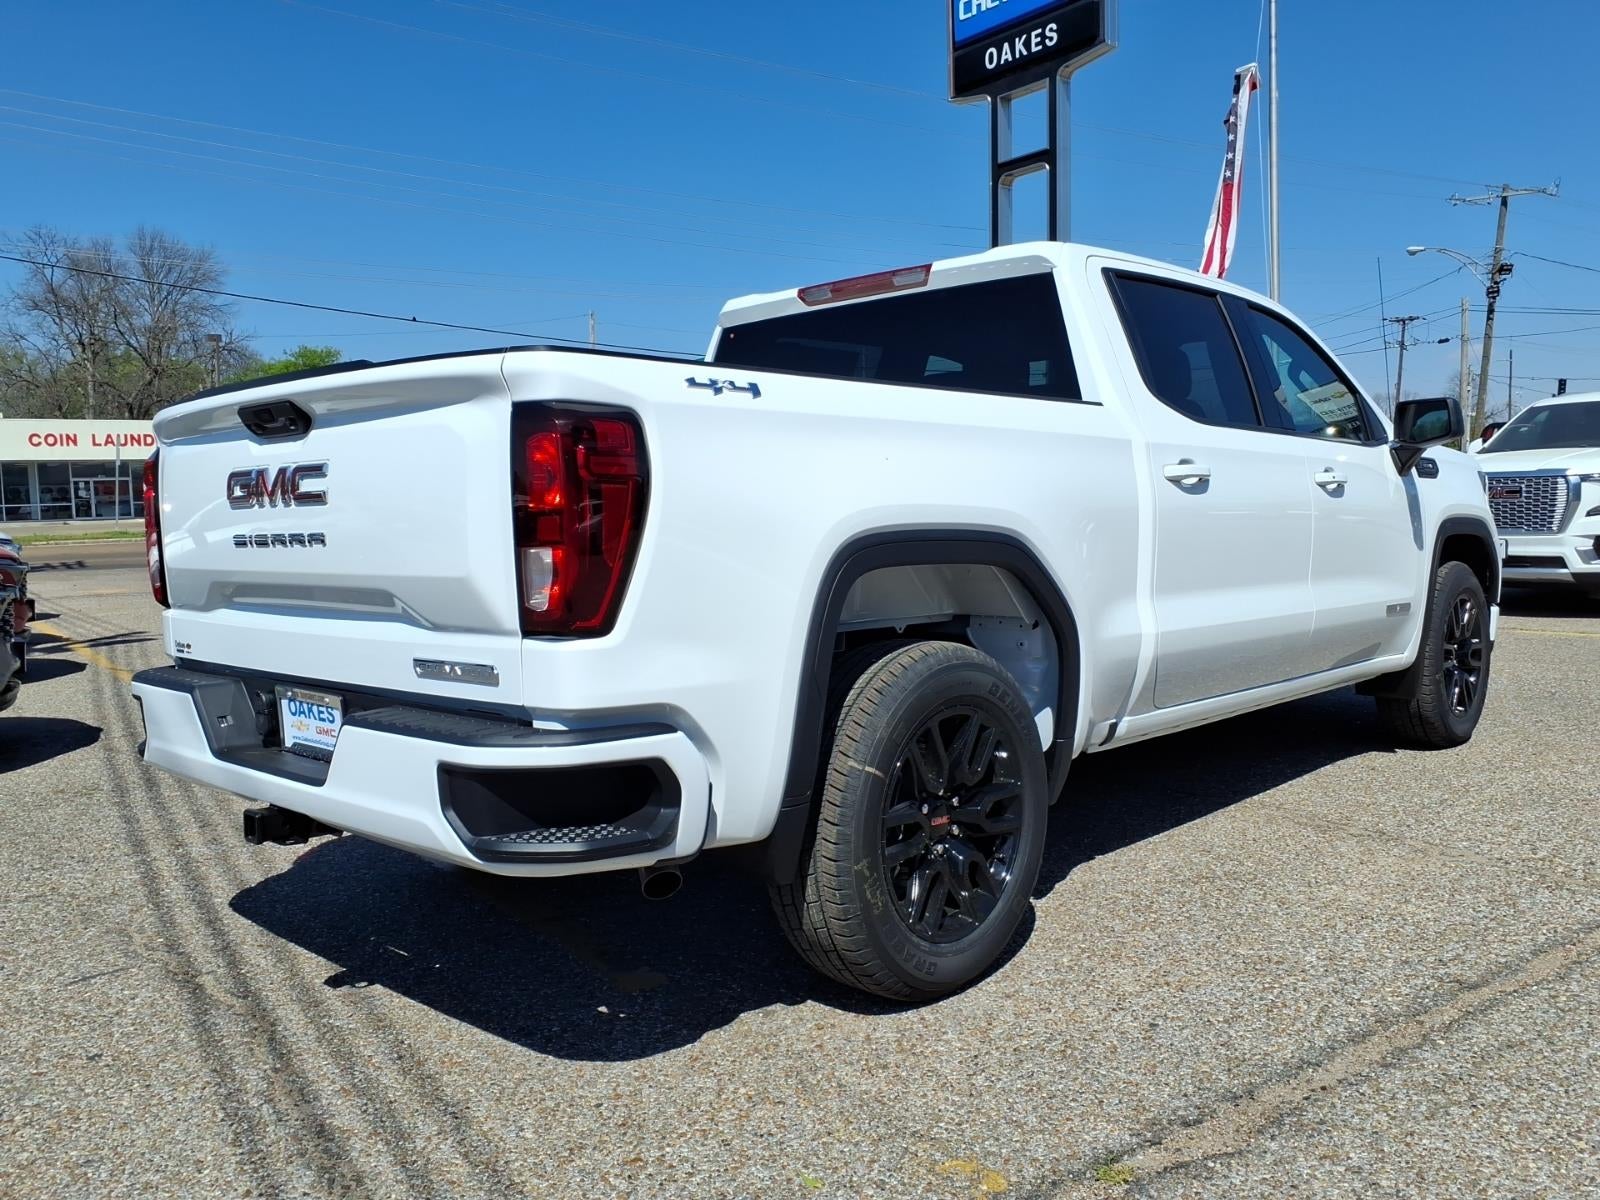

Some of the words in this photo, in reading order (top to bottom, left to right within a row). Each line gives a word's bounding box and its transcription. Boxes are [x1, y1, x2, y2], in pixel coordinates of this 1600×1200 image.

[984, 23, 1058, 69] OAKES
[28, 433, 78, 447] COIN
[227, 462, 329, 510] GMC
[232, 532, 327, 548] SIERRA
[287, 697, 336, 724] OAKES
[315, 725, 337, 738] GMC
[931, 815, 951, 826] GMC
